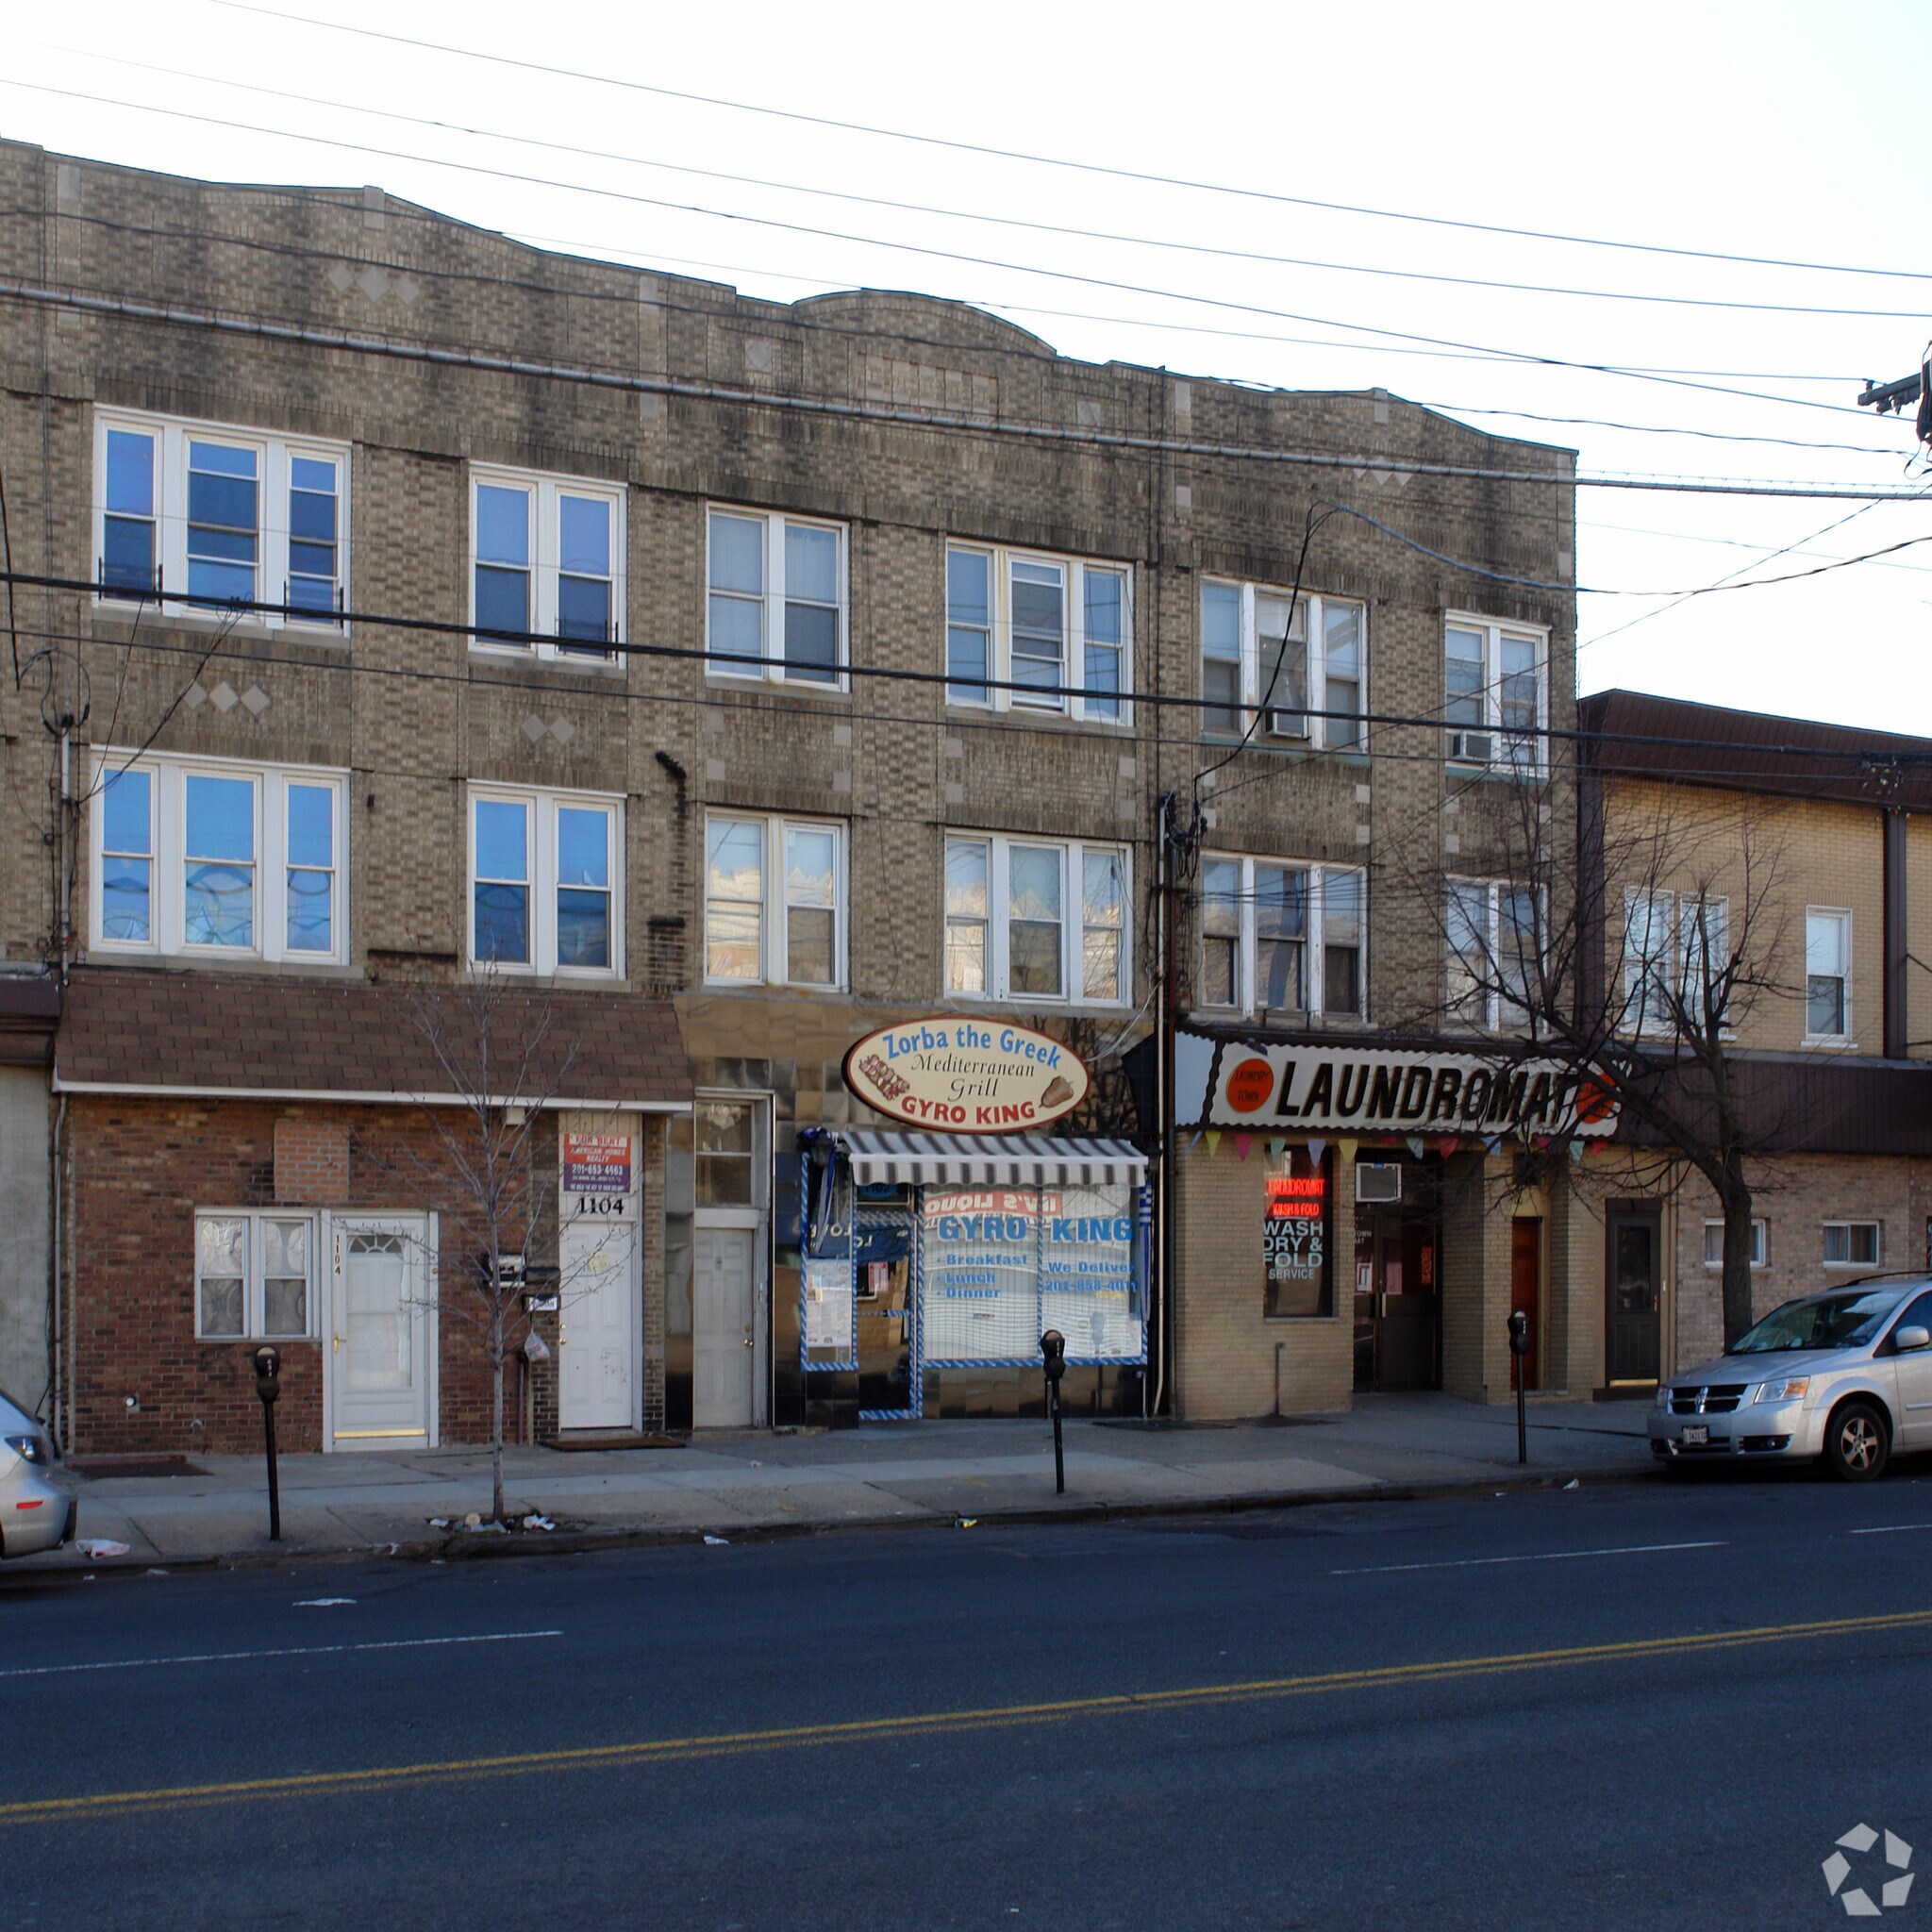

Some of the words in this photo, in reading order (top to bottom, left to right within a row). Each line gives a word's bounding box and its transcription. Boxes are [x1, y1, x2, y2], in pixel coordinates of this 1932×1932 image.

[883, 1026, 948, 1059] Zorba
[956, 1024, 991, 1049] the
[999, 1029, 1061, 1070] Greek
[910, 1054, 1035, 1077] Mediterranean
[947, 1078, 1000, 1102] Grill
[1238, 1090, 1259, 1102] TOWN
[1274, 1060, 1580, 1124] LAUNDROMAT
[901, 1095, 966, 1124] GYRO
[976, 1101, 1035, 1124] KING
[1268, 1178, 1324, 1195] LAUNDROMAT
[579, 1197, 625, 1215] 1104
[1273, 1203, 1293, 1216] WASH
[1301, 1203, 1320, 1216] FOLD
[938, 1216, 1027, 1242] GYRO
[1050, 1217, 1133, 1242] KING
[1263, 1220, 1324, 1236] WASH
[1263, 1236, 1303, 1252] DRY
[1309, 1237, 1323, 1252] &
[946, 1254, 1028, 1265] Breakfast
[1048, 1261, 1072, 1274] We
[1078, 1261, 1135, 1274] Deliver
[1263, 1252, 1323, 1268] FOLD
[946, 1272, 996, 1284] Lunch
[1268, 1269, 1315, 1280] SERVICE
[946, 1287, 1001, 1299] Dinner
